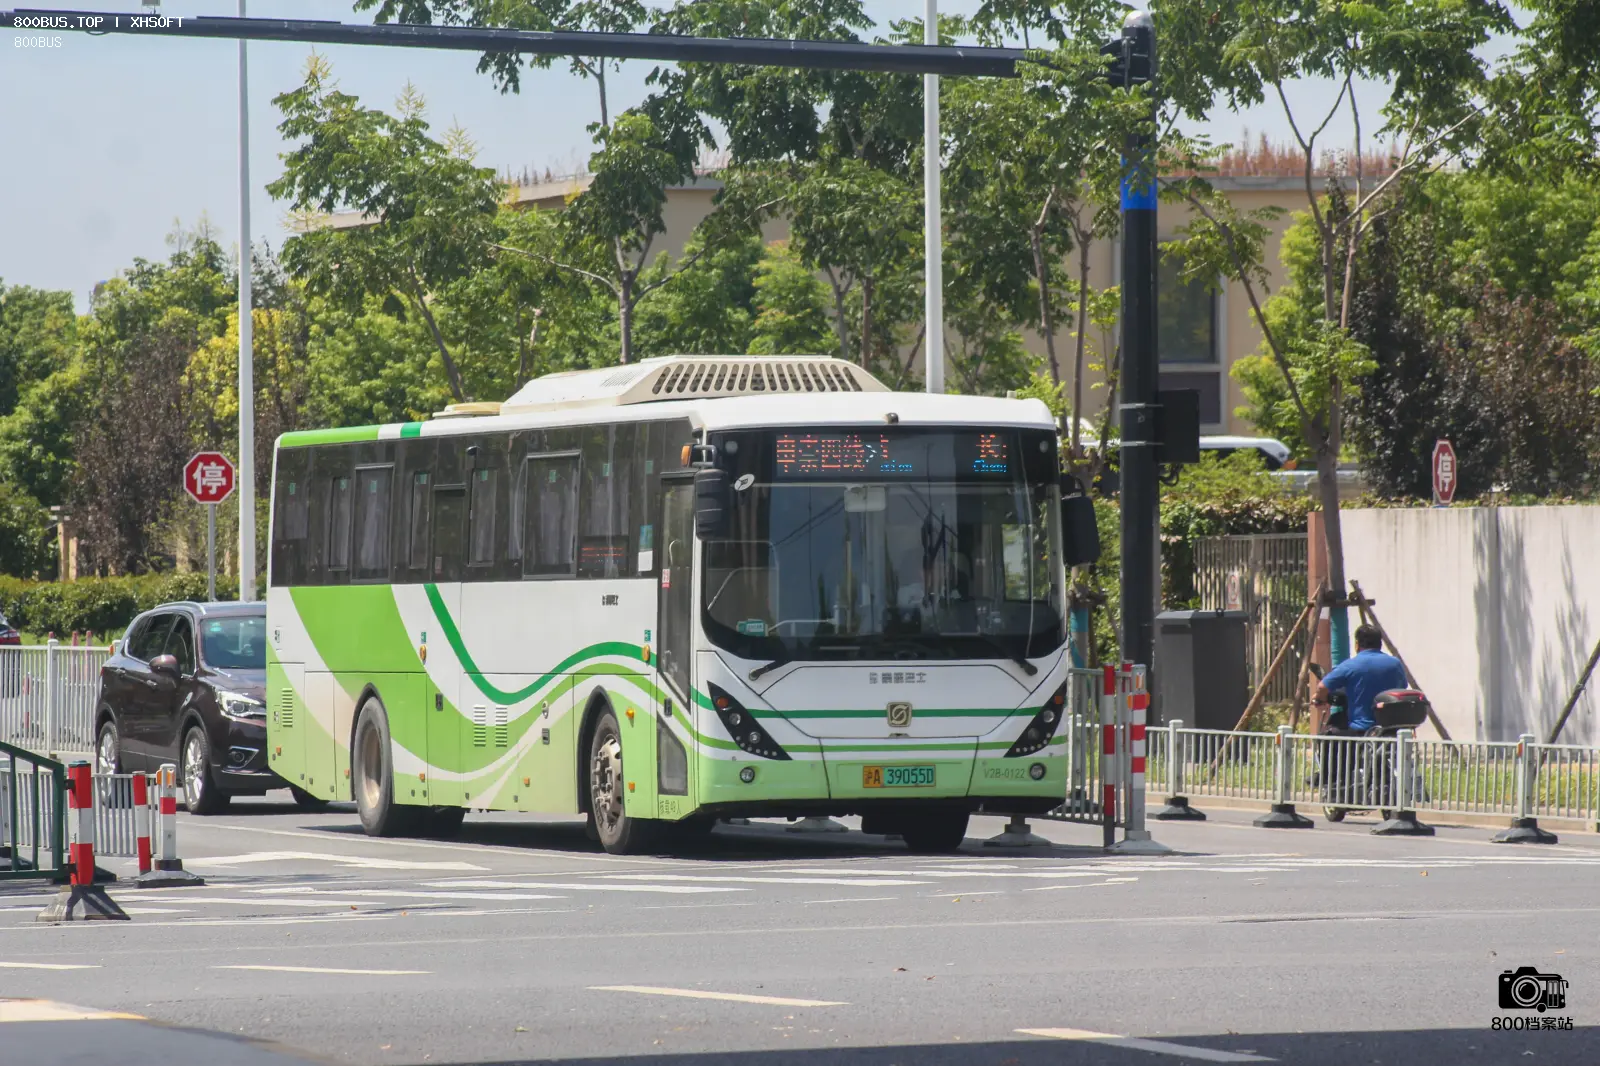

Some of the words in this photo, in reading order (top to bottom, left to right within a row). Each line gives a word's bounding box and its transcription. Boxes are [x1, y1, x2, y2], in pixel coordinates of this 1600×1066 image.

[192, 461, 227, 495] 停
[1437, 452, 1453, 492] 停
[887, 767, 934, 785] 39055D
